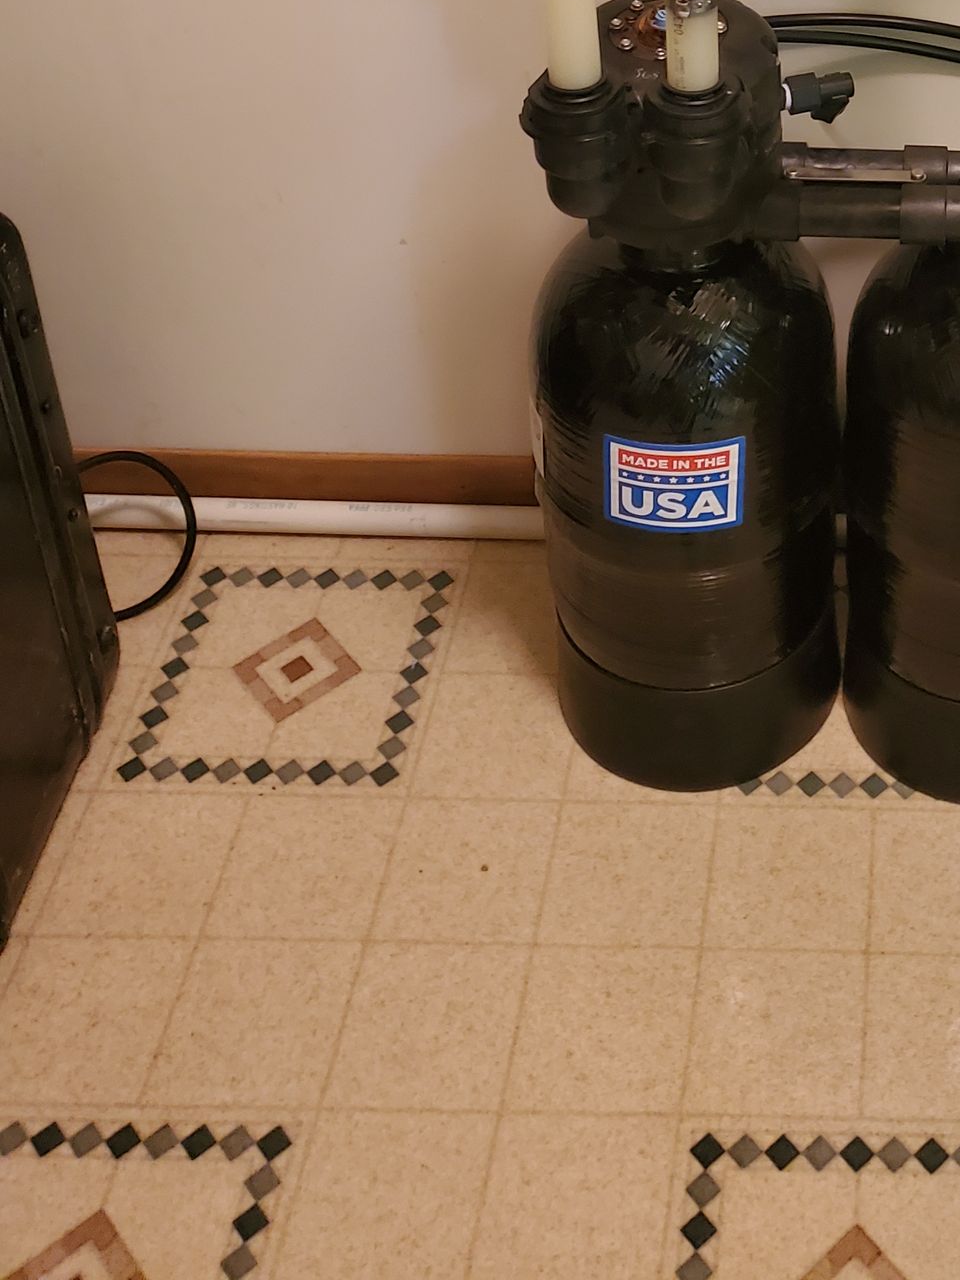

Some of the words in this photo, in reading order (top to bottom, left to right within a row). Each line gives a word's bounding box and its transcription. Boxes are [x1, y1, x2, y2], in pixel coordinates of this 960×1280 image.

[622, 453, 669, 469] MADE
[673, 460, 690, 470] IN
[694, 455, 727, 468] THE
[621, 485, 726, 520] USA
